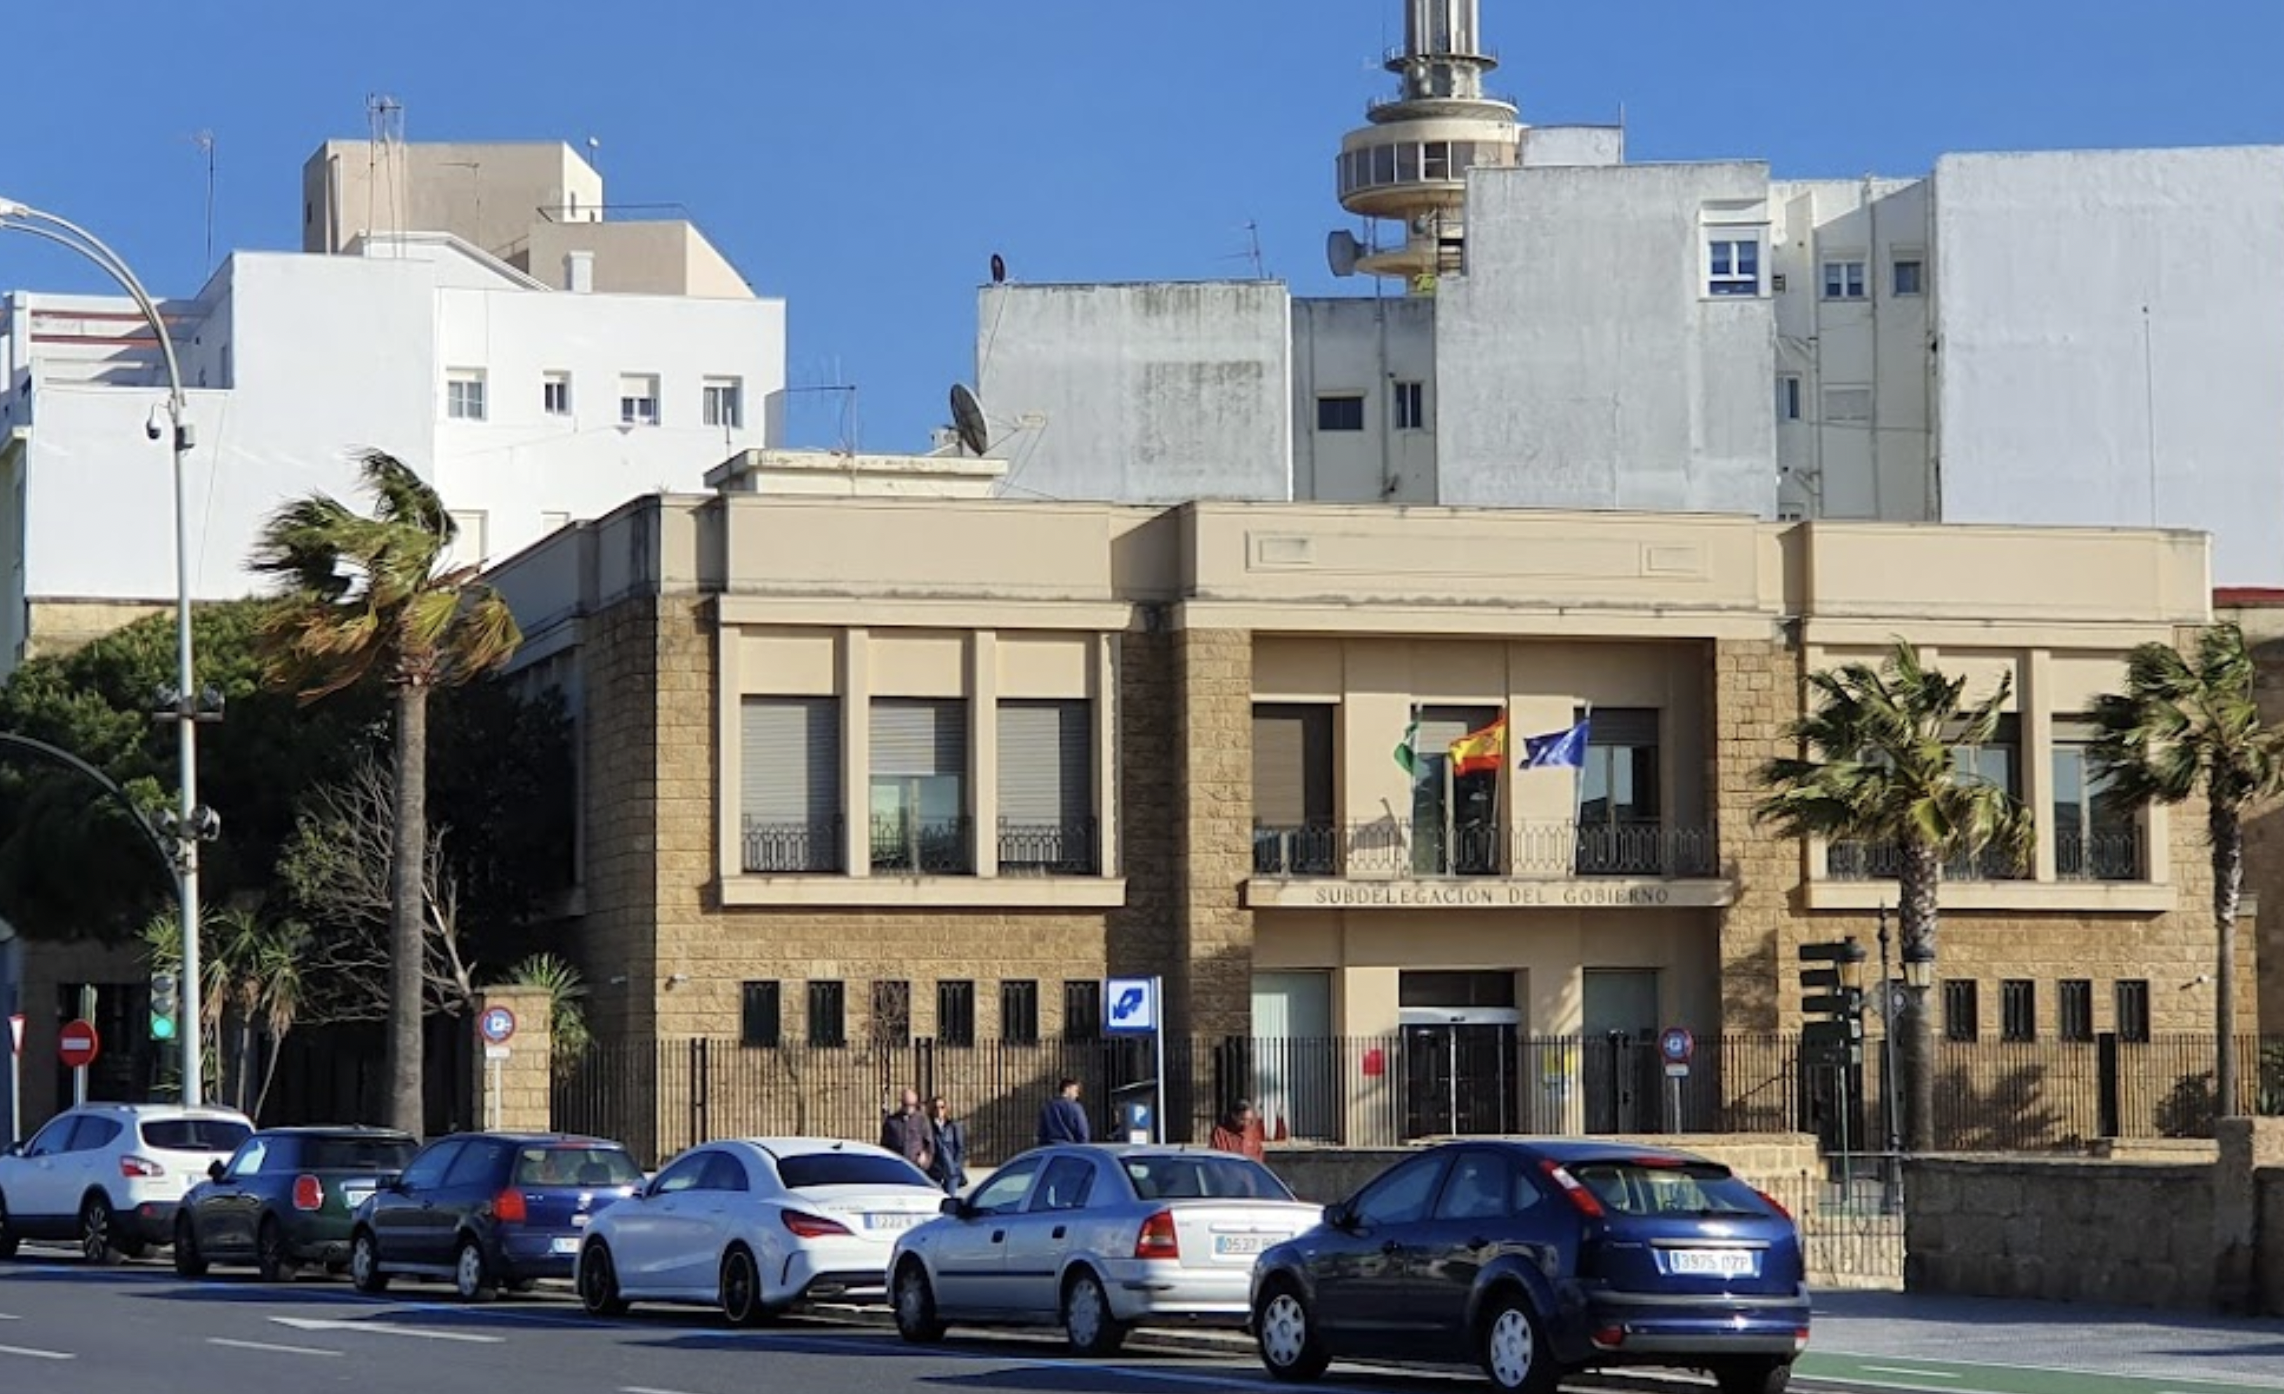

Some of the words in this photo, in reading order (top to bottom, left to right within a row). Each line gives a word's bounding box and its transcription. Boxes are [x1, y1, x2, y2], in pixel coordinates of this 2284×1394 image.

[1316, 887, 1492, 904] SUBDELEGACION
[1509, 887, 1546, 904] DEL
[1564, 887, 1669, 904] GOBIERNO
[1134, 1105, 1147, 1122] P
